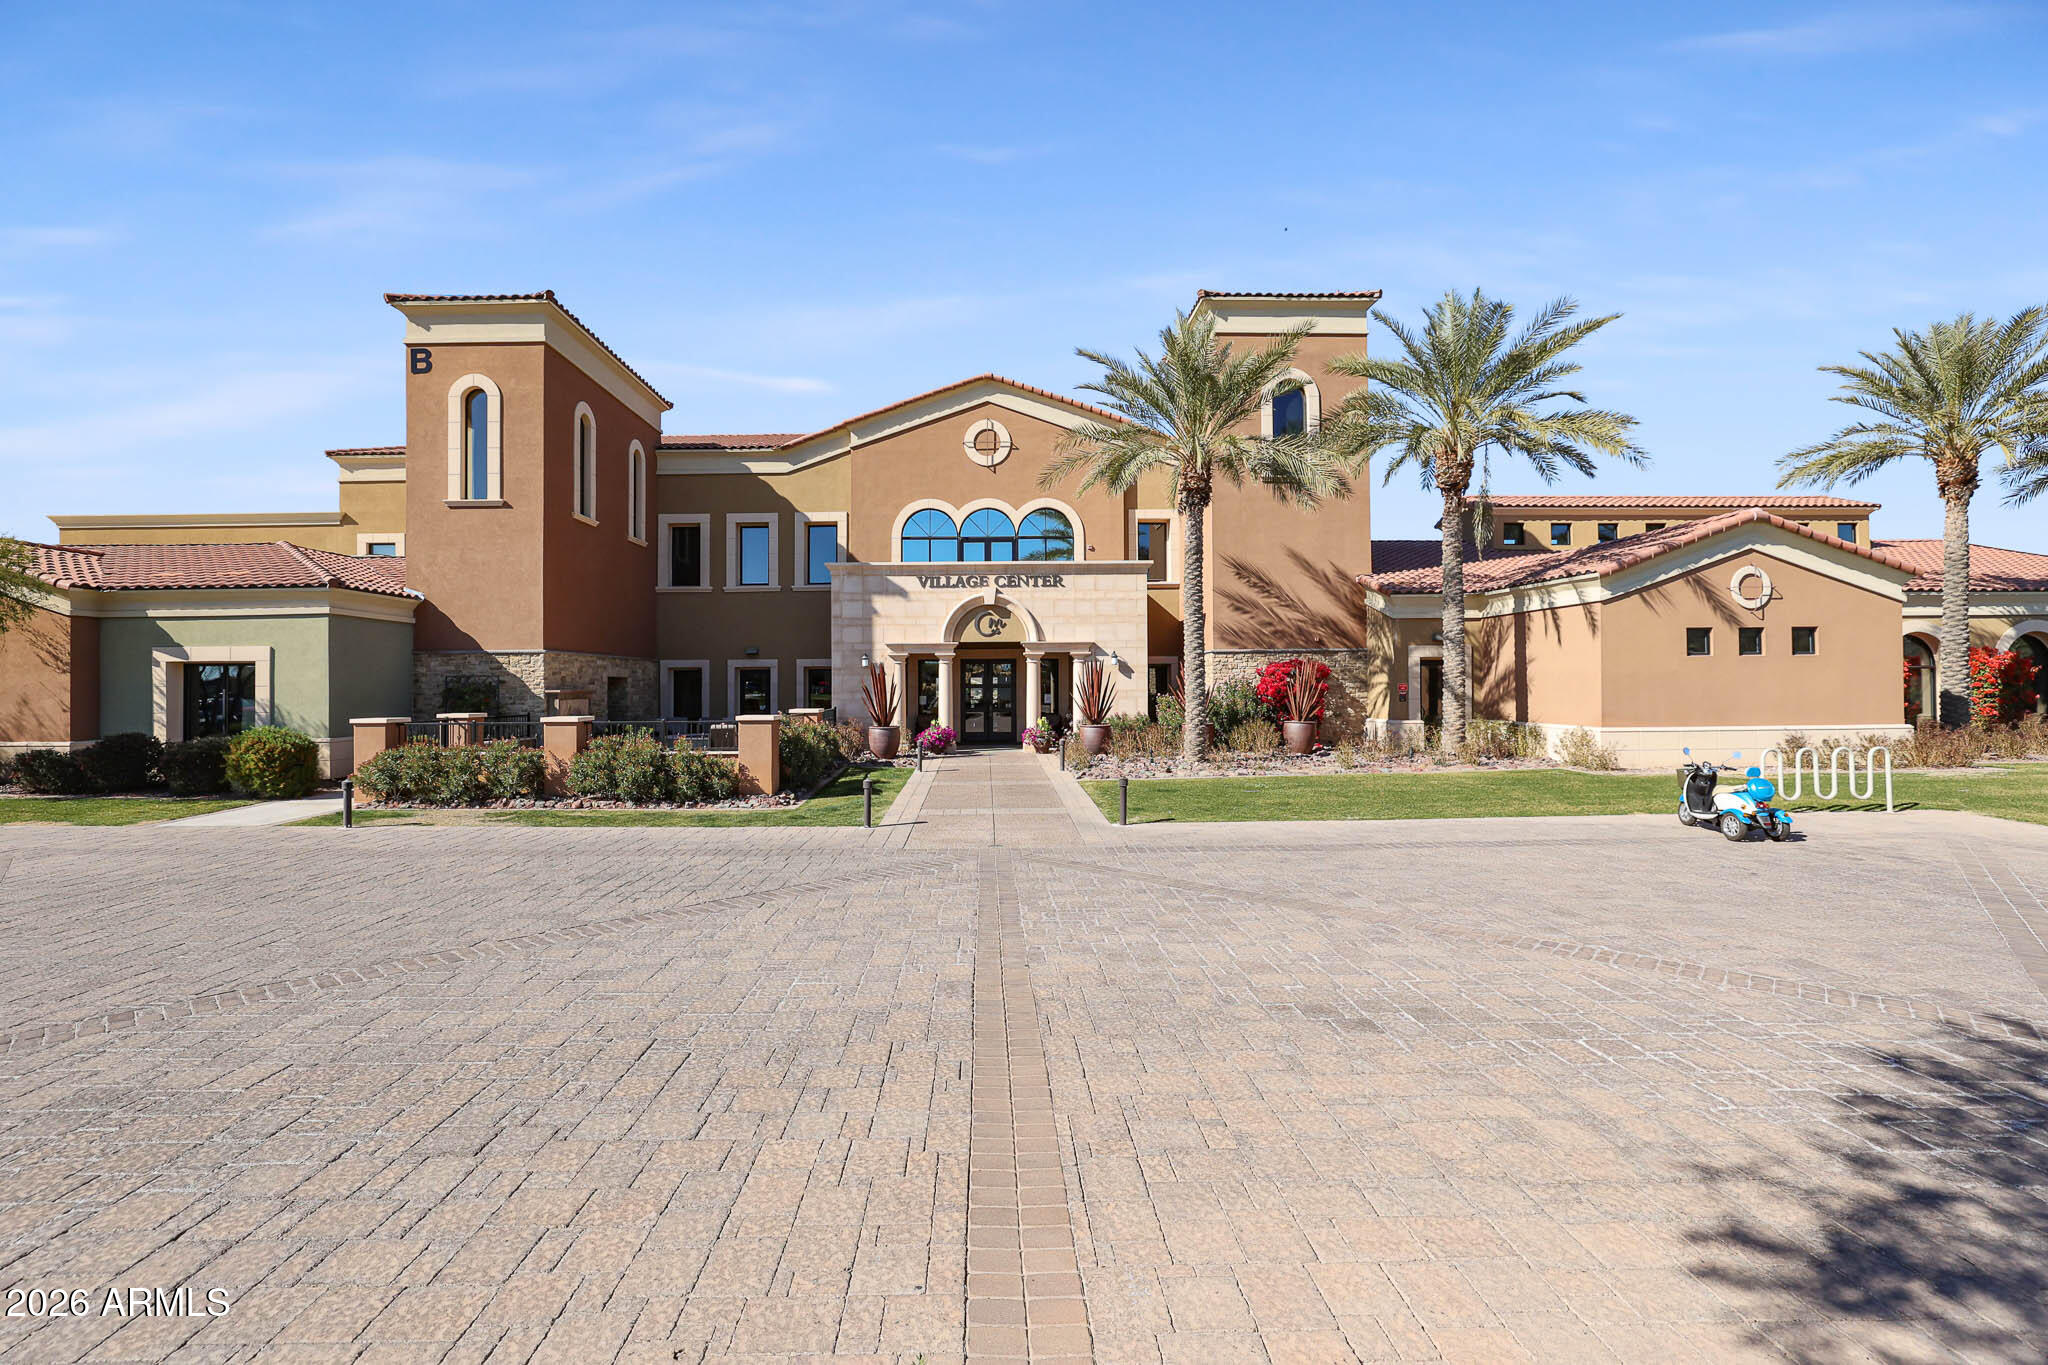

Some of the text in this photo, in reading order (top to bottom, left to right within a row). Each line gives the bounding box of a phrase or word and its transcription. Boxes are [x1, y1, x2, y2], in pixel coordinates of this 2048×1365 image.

[410, 348, 433, 375] B
[917, 575, 1065, 589] VILLAGE CENTER
